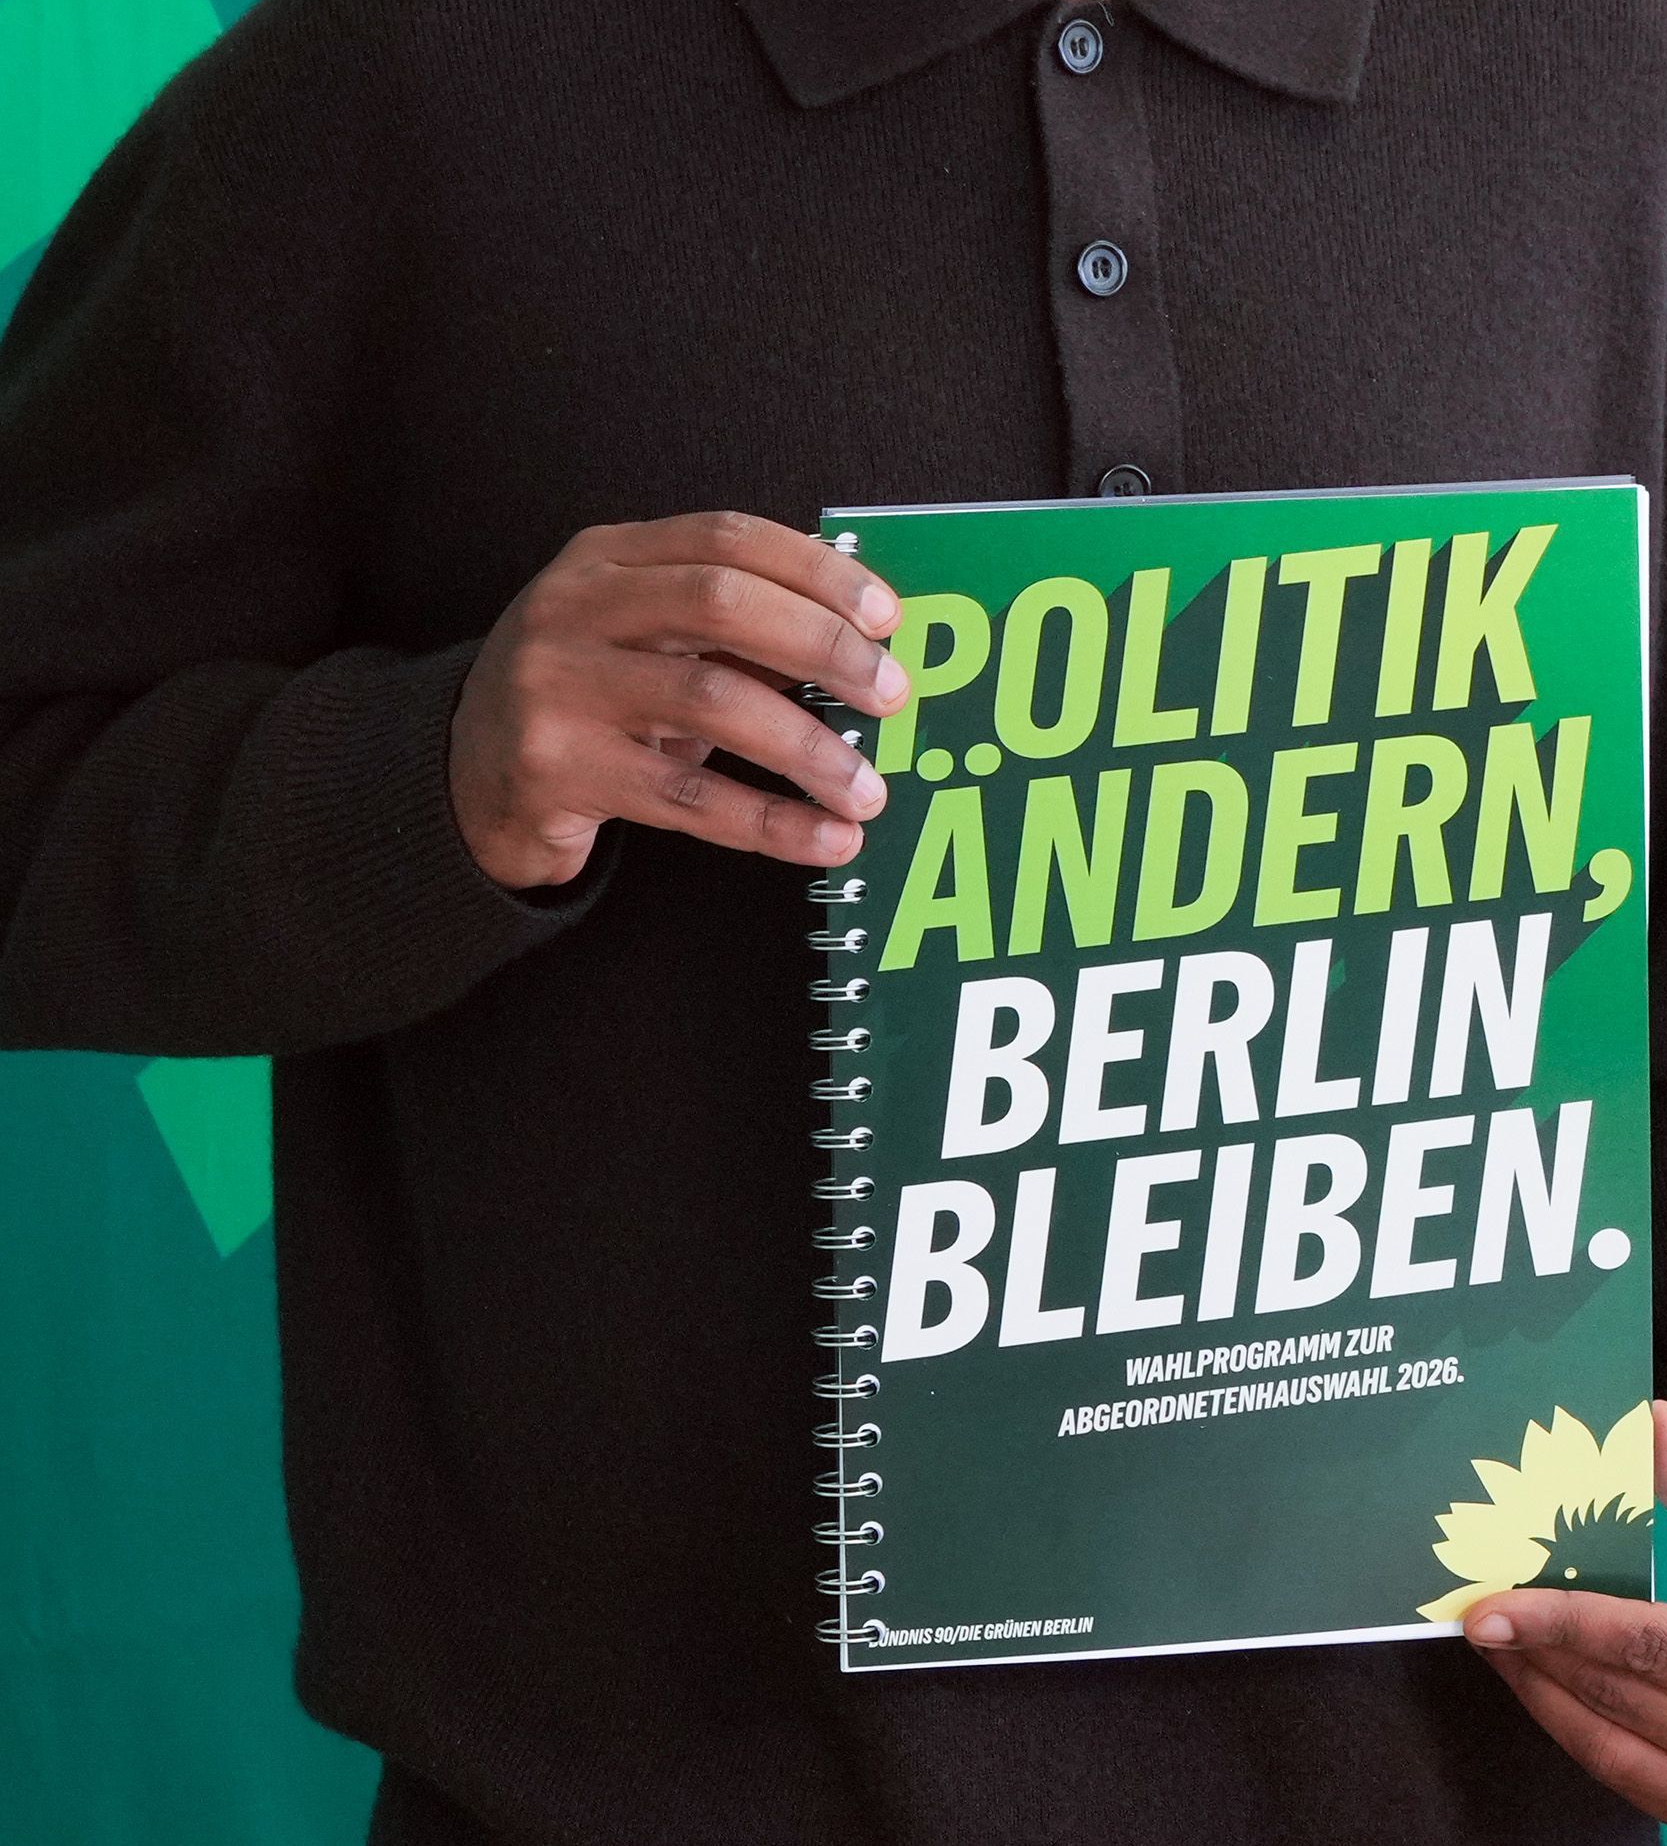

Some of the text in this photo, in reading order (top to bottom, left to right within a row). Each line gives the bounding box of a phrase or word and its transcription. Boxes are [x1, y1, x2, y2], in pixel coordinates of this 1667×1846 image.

[875, 525, 1558, 774] POLITIK
[878, 715, 1633, 971] ÄNDERN,
[940, 912, 1554, 1160] BERLIN
[880, 1100, 1633, 1363] BLEIBEN.
[1125, 1324, 1395, 1386] WAHLPROGRAMM ZUR
[1057, 1356, 1466, 1437] ABGEORDNETENHAUSWAHL 2026.
[934, 1623, 984, 1646] 90/DIE
[983, 1618, 1042, 1640] GRÜNEN
[1043, 1616, 1095, 1636] BERLIN
